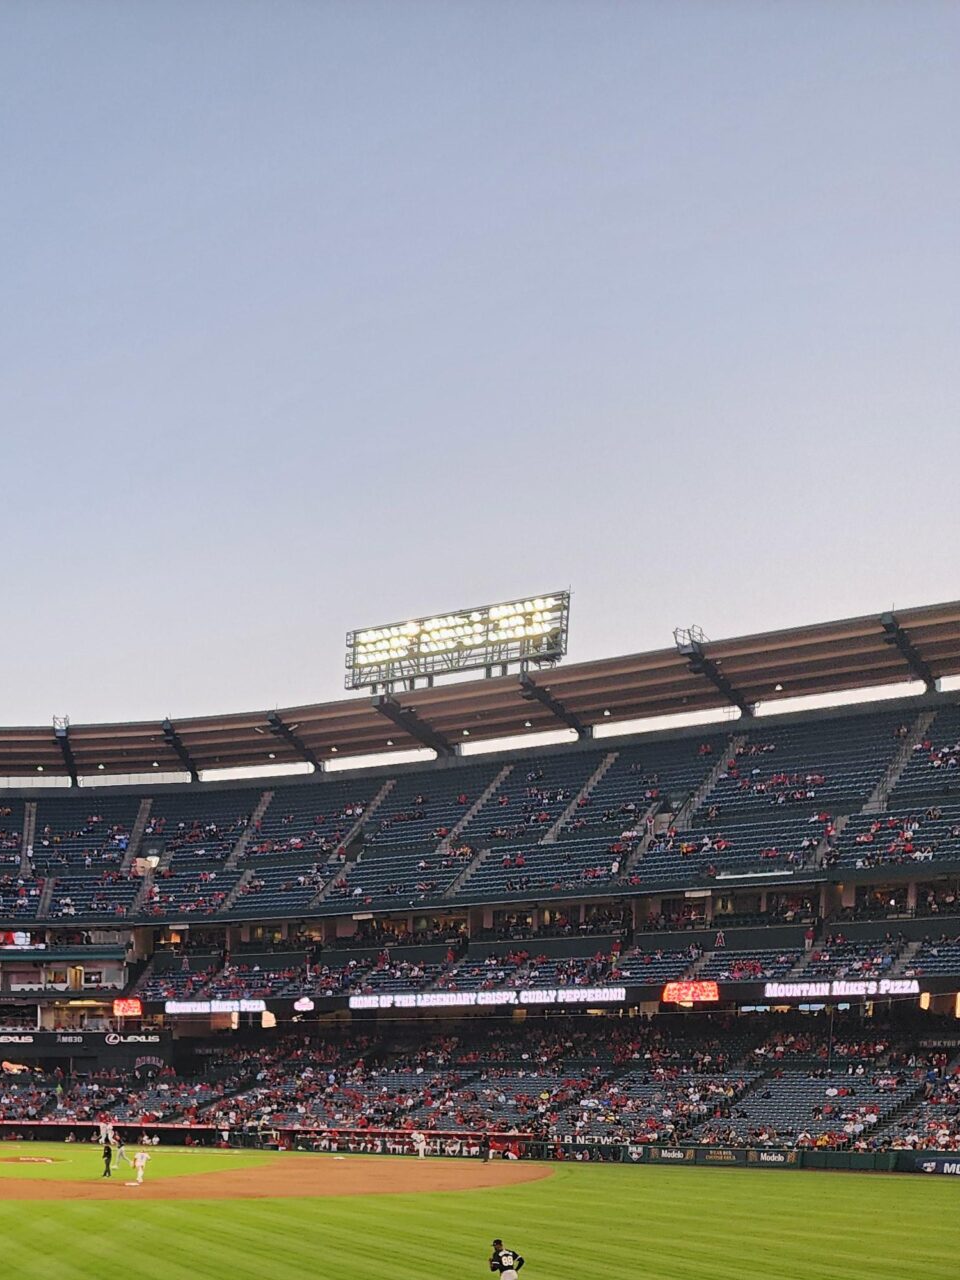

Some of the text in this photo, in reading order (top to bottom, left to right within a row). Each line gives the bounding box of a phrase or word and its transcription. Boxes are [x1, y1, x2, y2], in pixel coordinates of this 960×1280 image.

[764, 979, 920, 998] MOUNTAIN MIKE'S PIZZA
[349, 996, 379, 1008] HOME
[380, 995, 393, 1007] OF
[394, 994, 416, 1007] THE
[417, 993, 476, 1006] LEGENDARY
[477, 991, 519, 1004] CRISPY,
[520, 990, 556, 1003] CURLY
[120, 1035, 160, 1043] LEXUS
[661, 1151, 684, 1159] Modelo
[760, 1152, 784, 1162] Modelo
